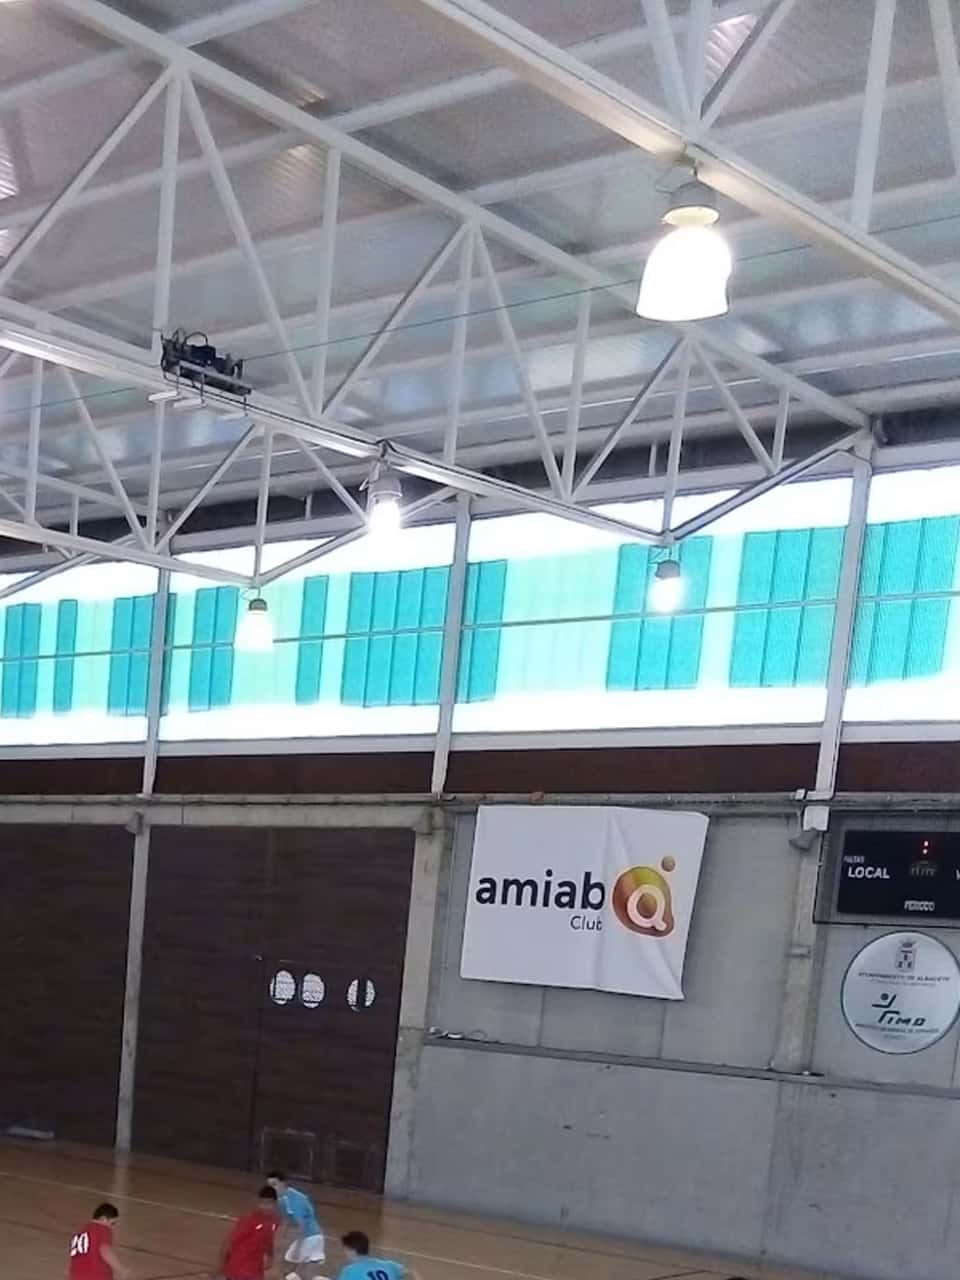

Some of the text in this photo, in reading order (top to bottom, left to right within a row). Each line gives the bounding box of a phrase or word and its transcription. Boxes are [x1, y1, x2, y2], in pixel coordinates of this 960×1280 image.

[847, 866, 890, 879] LOCAL
[475, 868, 606, 911] amiab
[570, 915, 603, 931] Club
